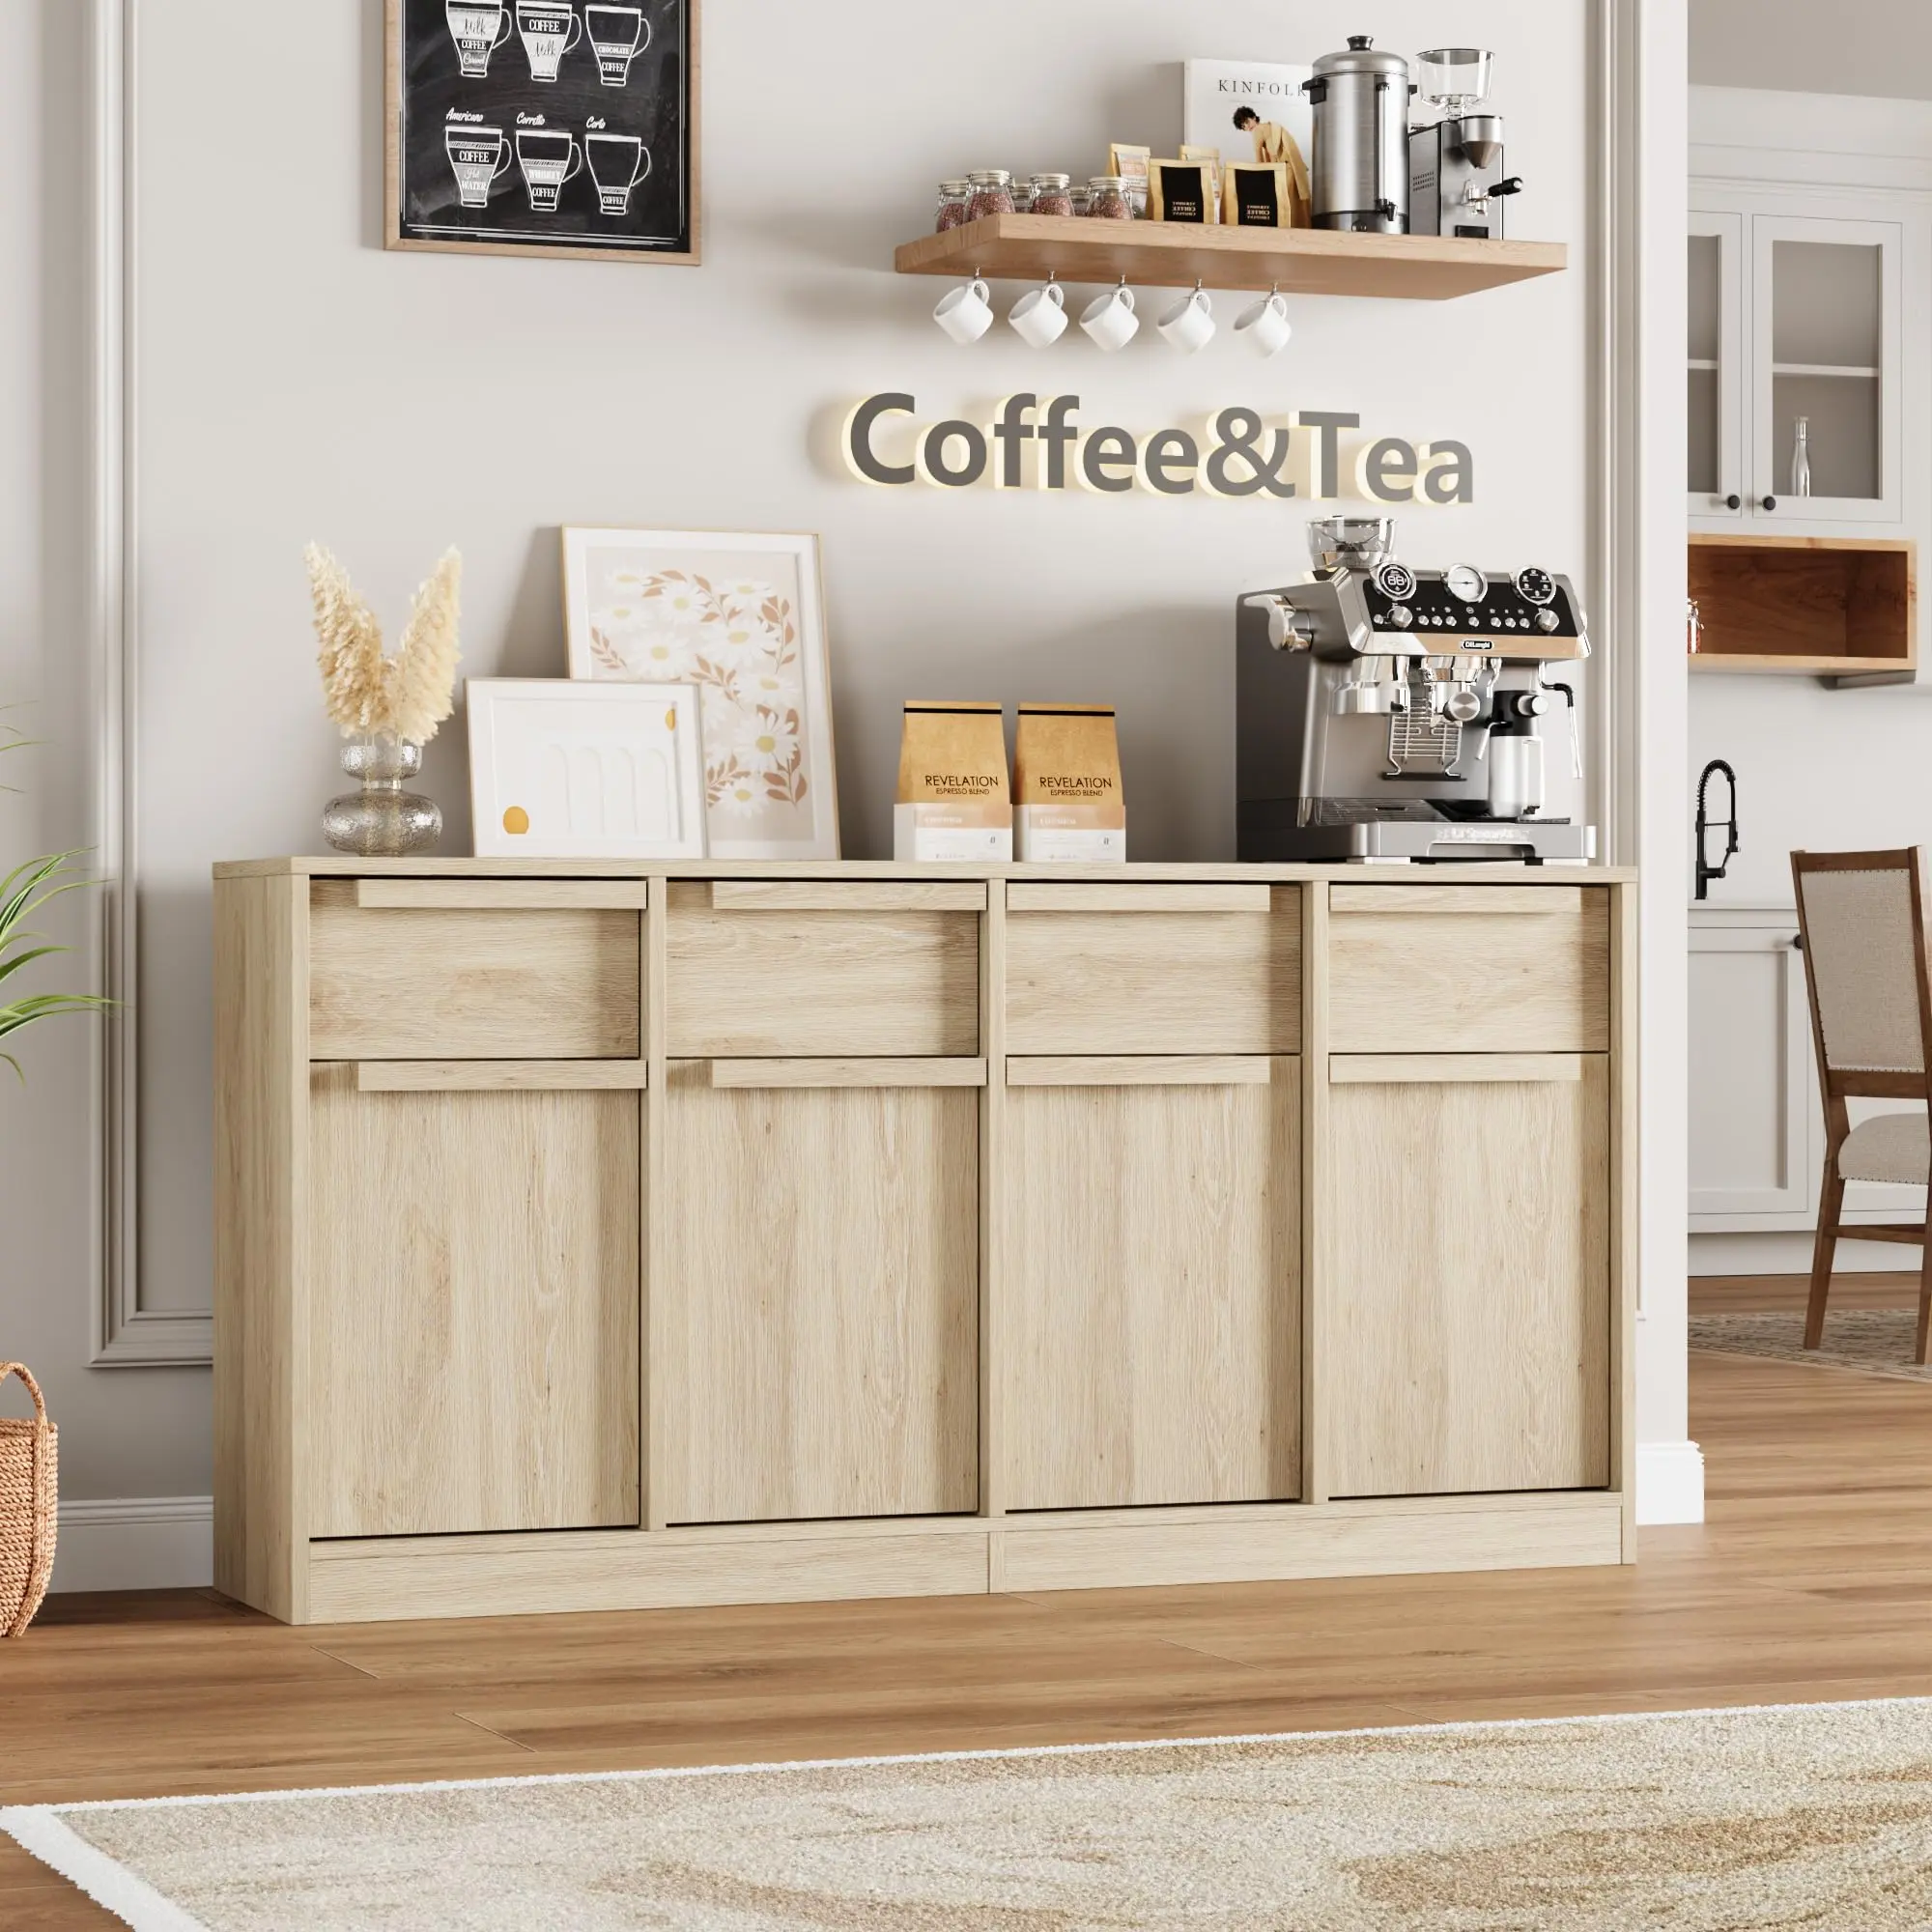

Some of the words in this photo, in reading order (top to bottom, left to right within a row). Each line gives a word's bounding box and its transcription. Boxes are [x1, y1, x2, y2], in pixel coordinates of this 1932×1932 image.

[528, 19, 560, 33] COFFEE
[461, 40, 487, 50] COFFEE
[597, 46, 630, 55] CHOCOLATE
[601, 62, 625, 72] COFFEE
[1217, 79, 1307, 97] KINFOLK
[445, 107, 484, 123] Americano
[516, 112, 546, 126] Corretto
[585, 116, 606, 129] Corto
[459, 150, 490, 163] COFFEE
[461, 181, 488, 191] WATER
[531, 187, 556, 198] COFFEE
[602, 195, 625, 205] COFFEE
[846, 391, 1474, 503] Coffee&Tea
[924, 775, 999, 787] REVELATION
[1039, 777, 1112, 788] REVELATION
